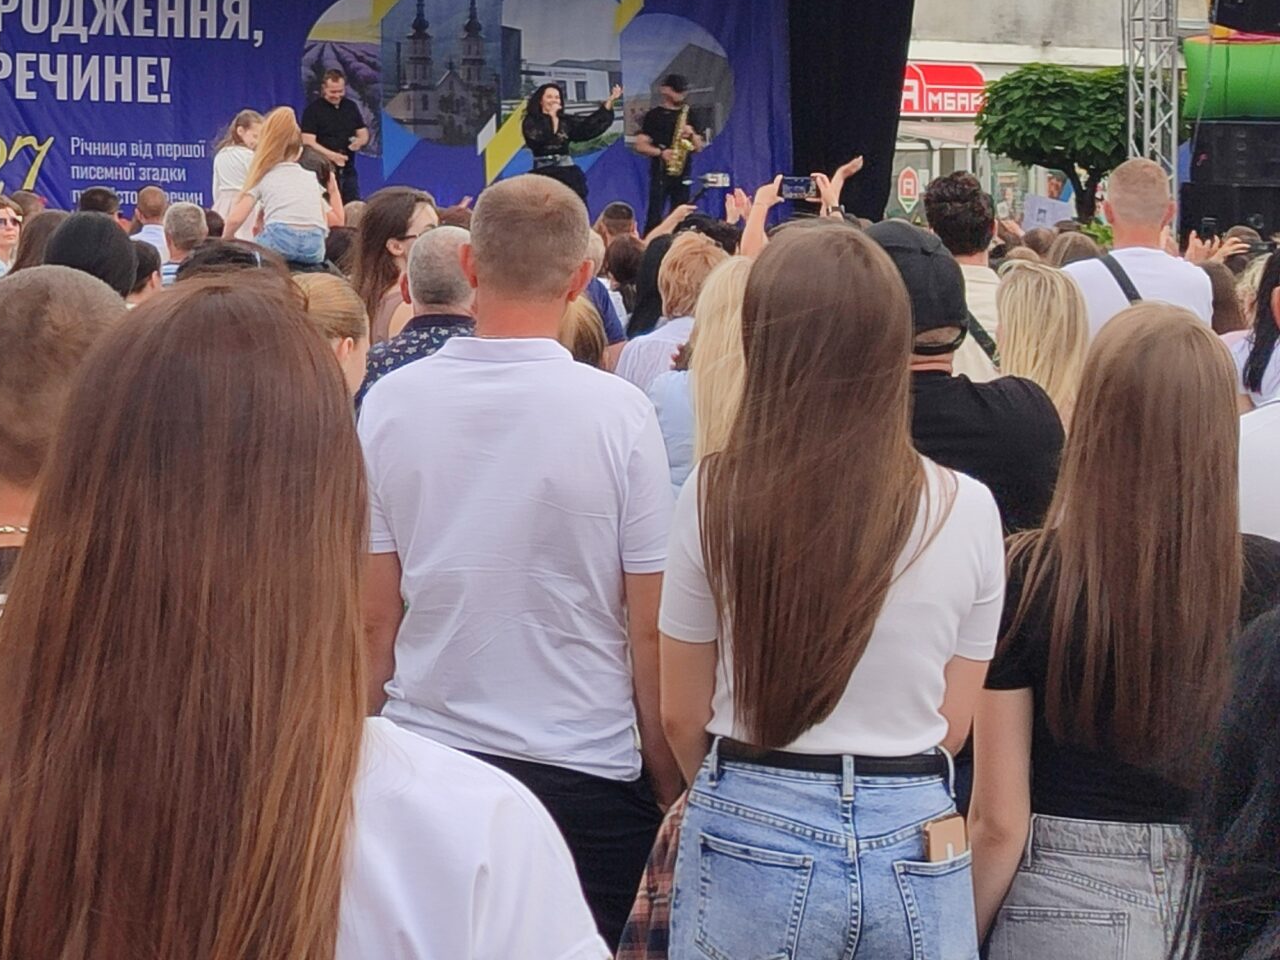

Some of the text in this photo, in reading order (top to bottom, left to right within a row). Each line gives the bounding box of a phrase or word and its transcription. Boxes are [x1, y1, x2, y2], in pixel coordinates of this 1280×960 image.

[70, 136, 206, 161] Річниця від першої
[70, 162, 186, 183] писемної згадки
